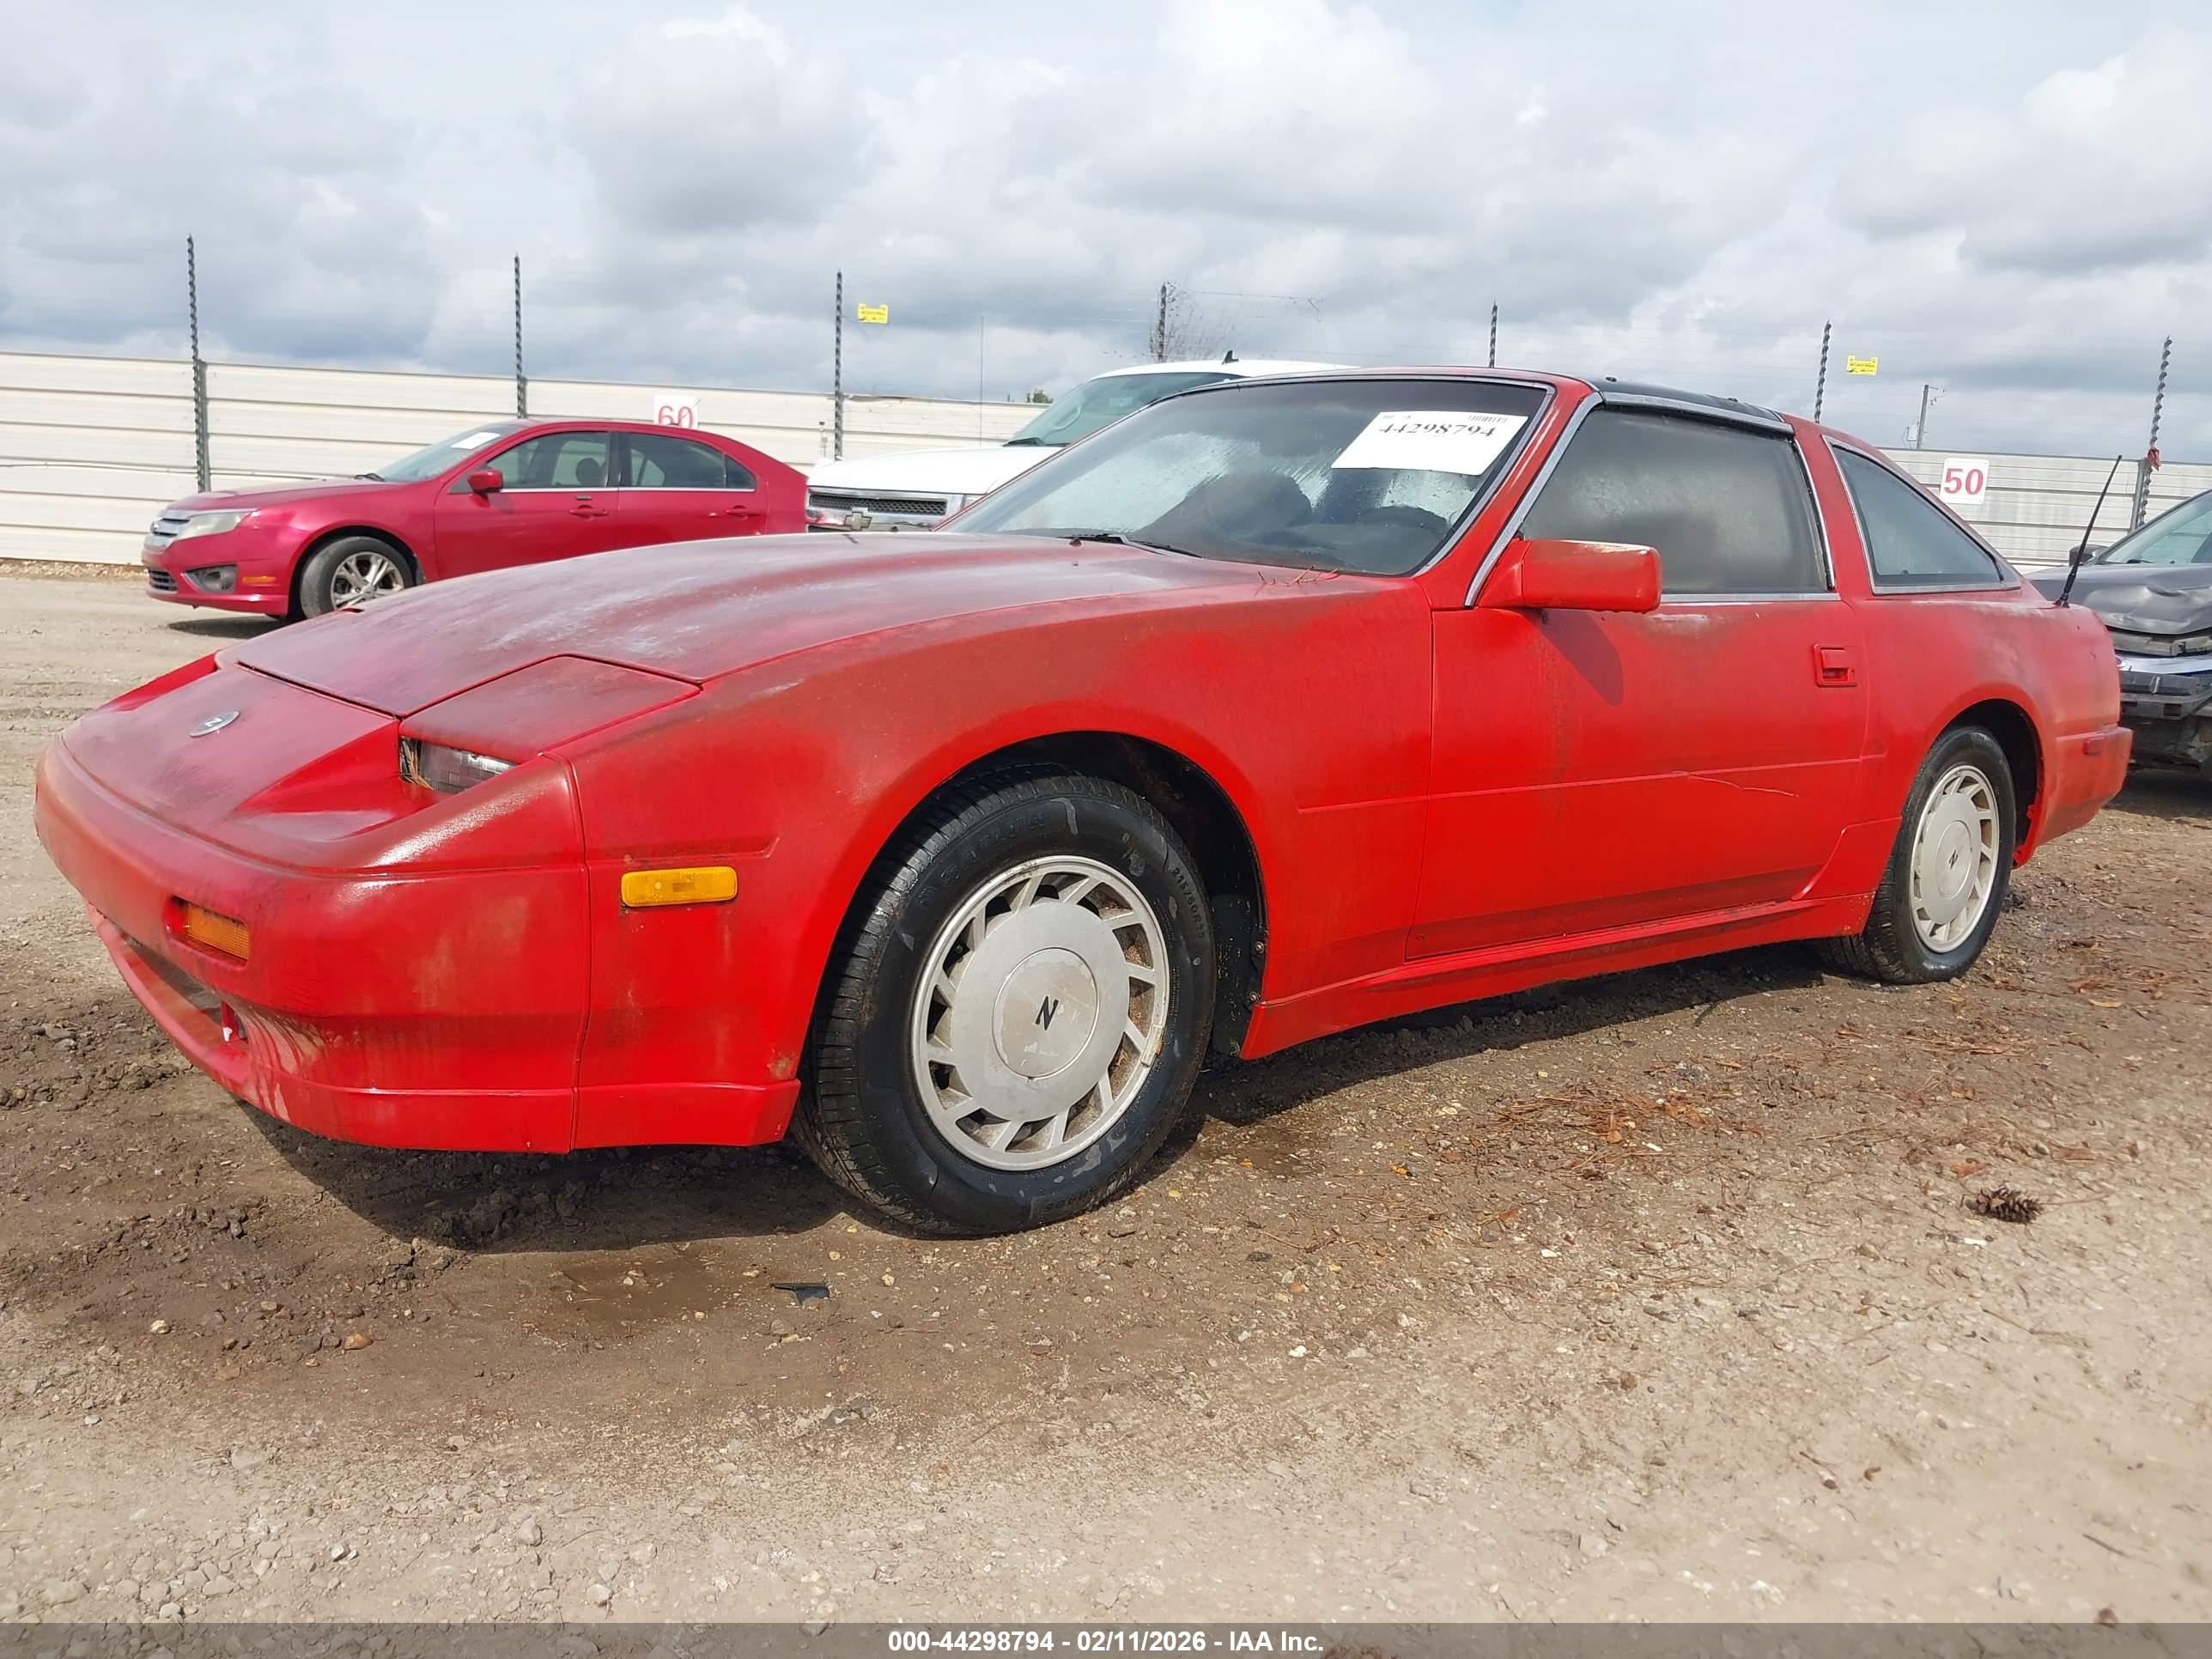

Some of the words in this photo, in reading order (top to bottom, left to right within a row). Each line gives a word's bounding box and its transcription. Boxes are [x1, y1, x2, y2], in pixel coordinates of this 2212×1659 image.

[659, 405, 694, 428] 60
[1378, 423, 1497, 437] 44298794
[1943, 467, 1984, 495] 50
